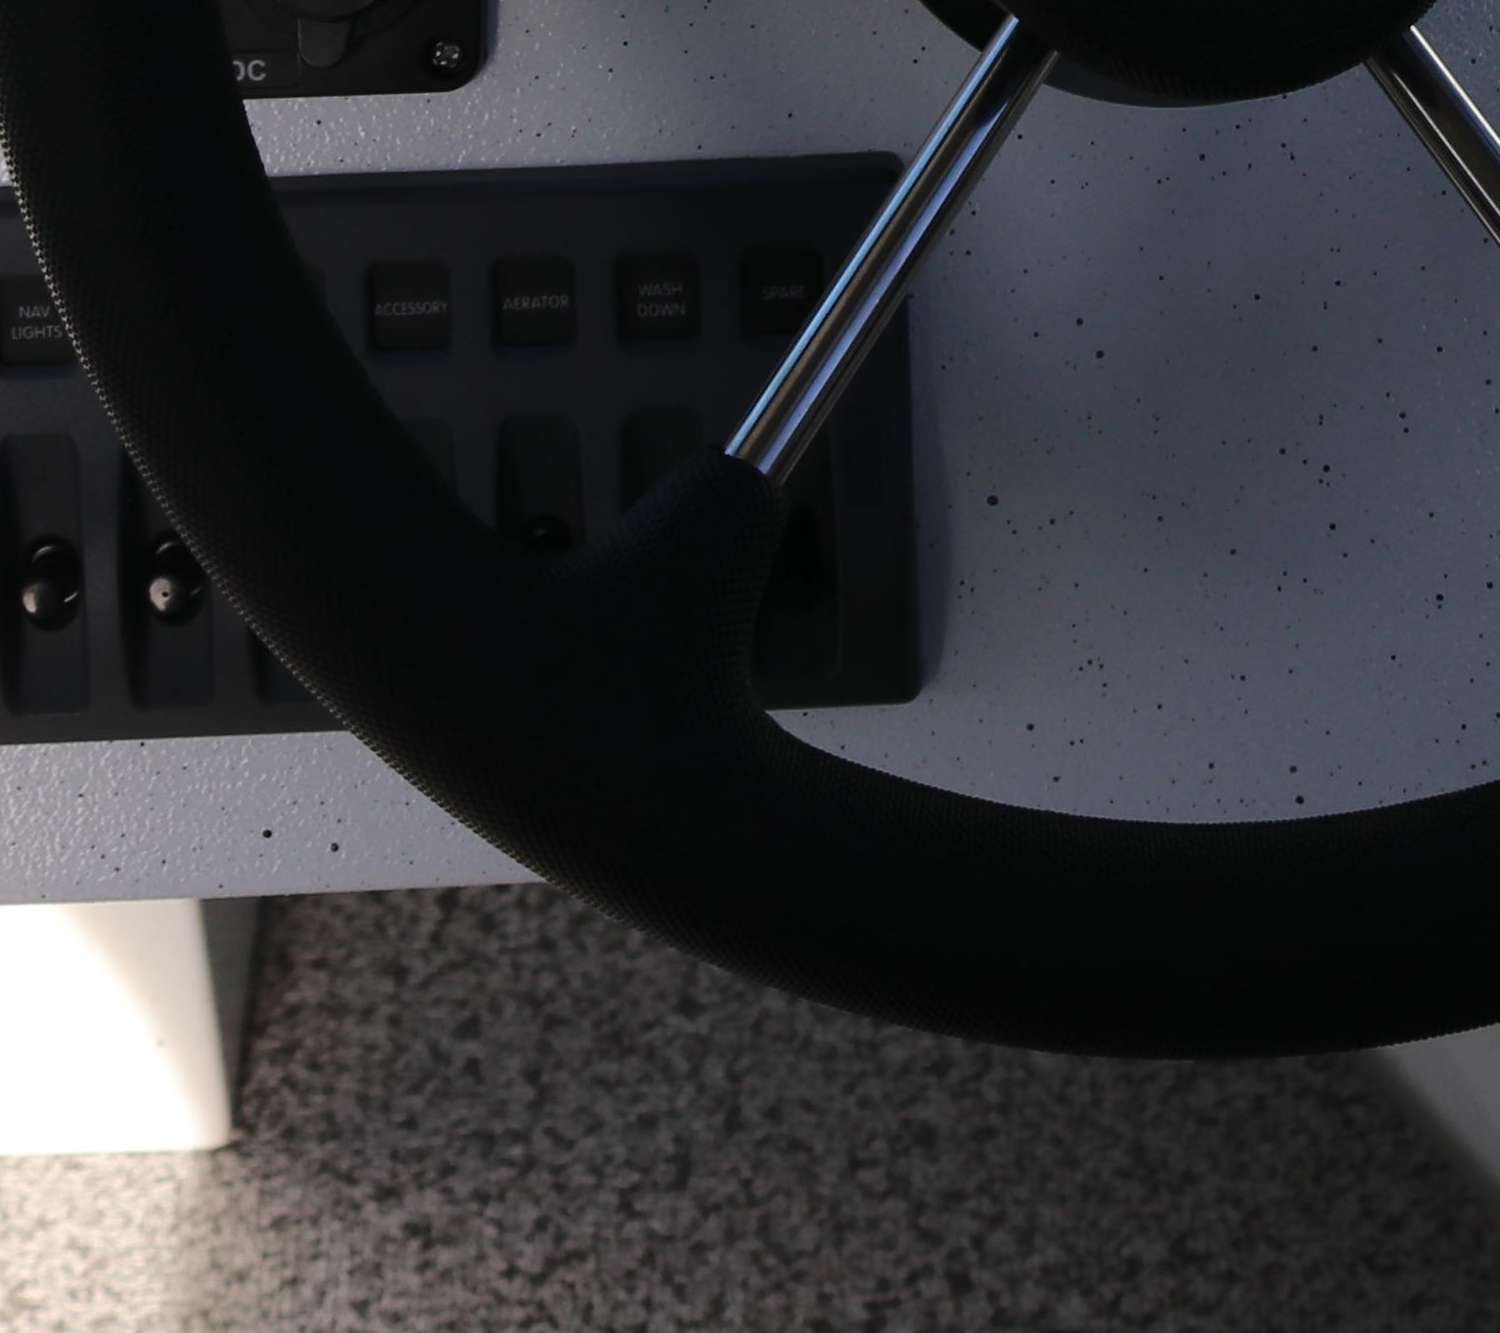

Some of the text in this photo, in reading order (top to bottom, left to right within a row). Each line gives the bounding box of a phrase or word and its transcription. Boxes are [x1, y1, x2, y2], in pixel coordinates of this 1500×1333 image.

[638, 281, 684, 297] WASH
[761, 284, 807, 301] SPARE
[373, 300, 449, 316] ACCESSORY
[501, 293, 570, 311] AERATOR
[636, 301, 687, 318] DOWN
[18, 305, 52, 319] NAV
[11, 325, 63, 340] LIGHTS
